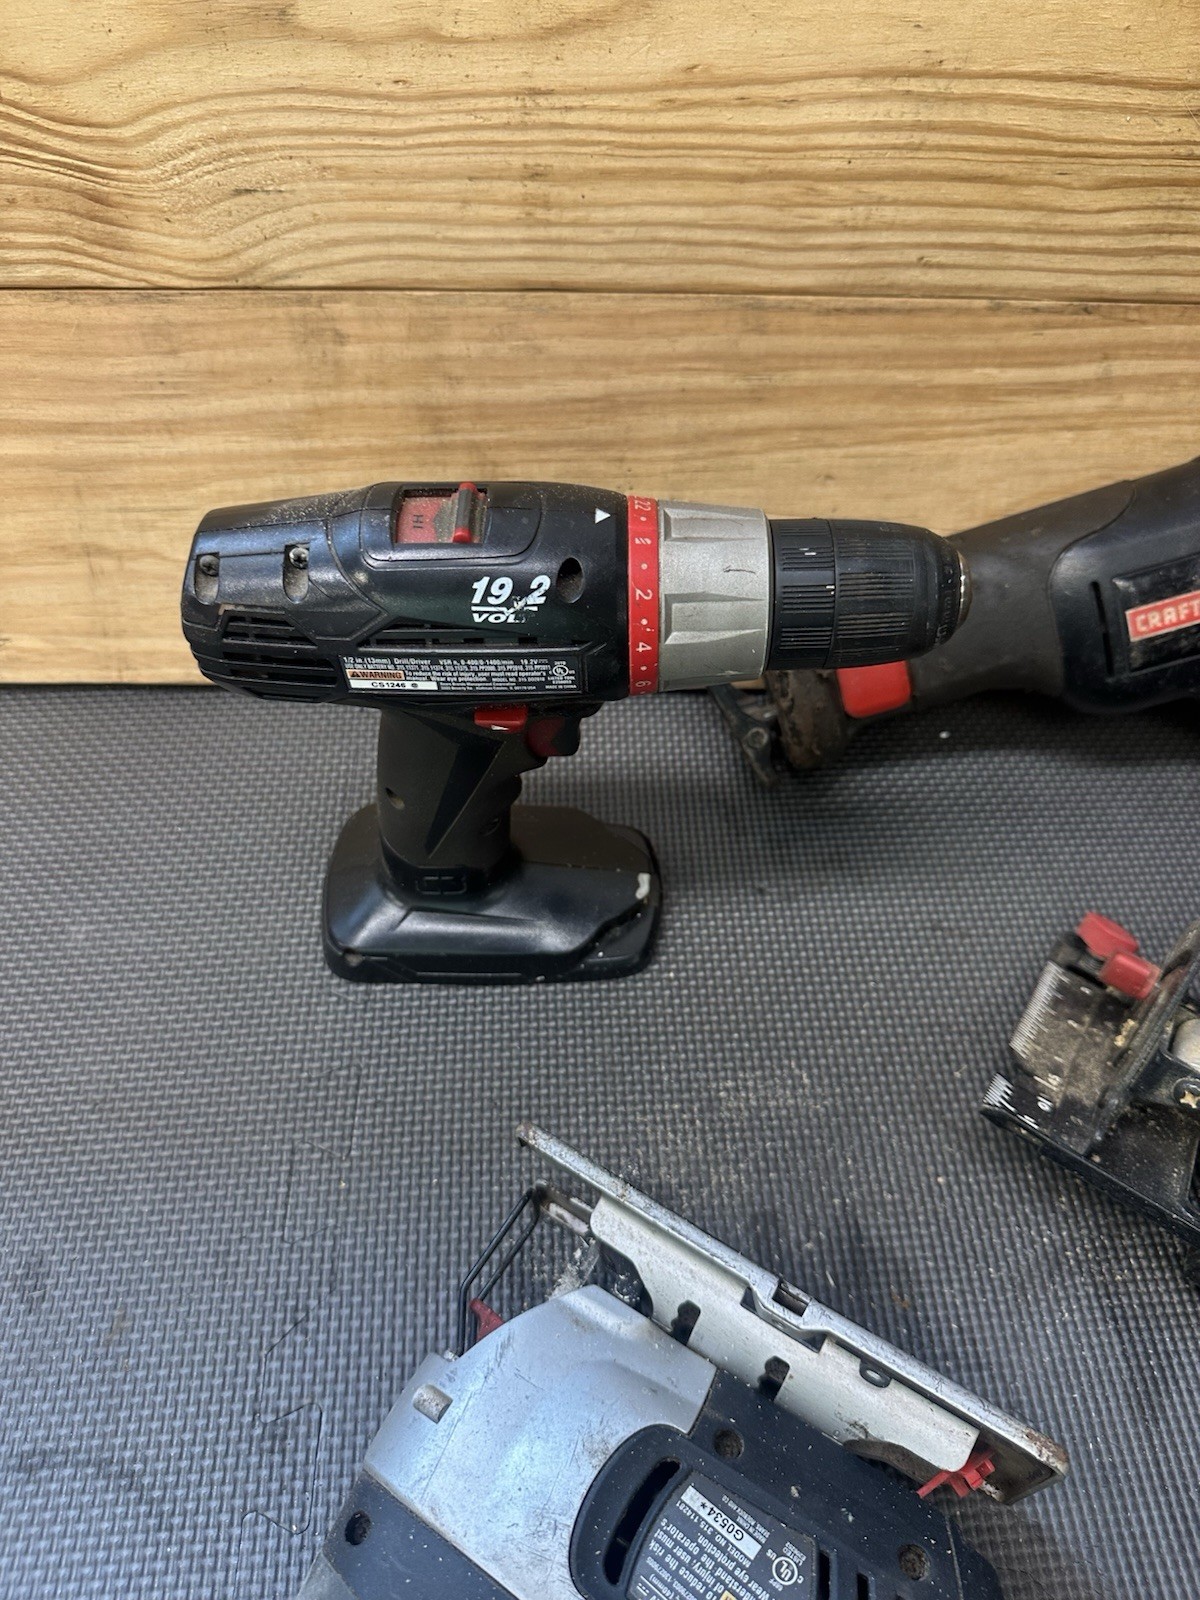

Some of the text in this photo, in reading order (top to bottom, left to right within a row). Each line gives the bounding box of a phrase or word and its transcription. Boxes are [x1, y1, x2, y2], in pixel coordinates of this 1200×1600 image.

[413, 514, 424, 529] HI
[635, 587, 653, 600] 2
[1135, 599, 1200, 632] CRAFT
[636, 641, 653, 653] 4
[343, 656, 355, 664] 1/2
[393, 657, 431, 665] Drill/Driver
[360, 671, 402, 679] WARNING
[653, 1528, 675, 1549] must
[658, 1516, 701, 1555] operator's
[675, 1499, 752, 1568] MODEL NO. 315.114281
[648, 1539, 665, 1557] risk
[672, 1545, 691, 1563] user
[692, 1531, 737, 1571] protection.
[765, 1548, 777, 1560] US
[781, 1546, 803, 1566] LISTED
[662, 1553, 680, 1570] the
[698, 1553, 715, 1570] the
[676, 1566, 707, 1594] reduce
[732, 1565, 751, 1583] eye
[712, 1582, 725, 1595] of
